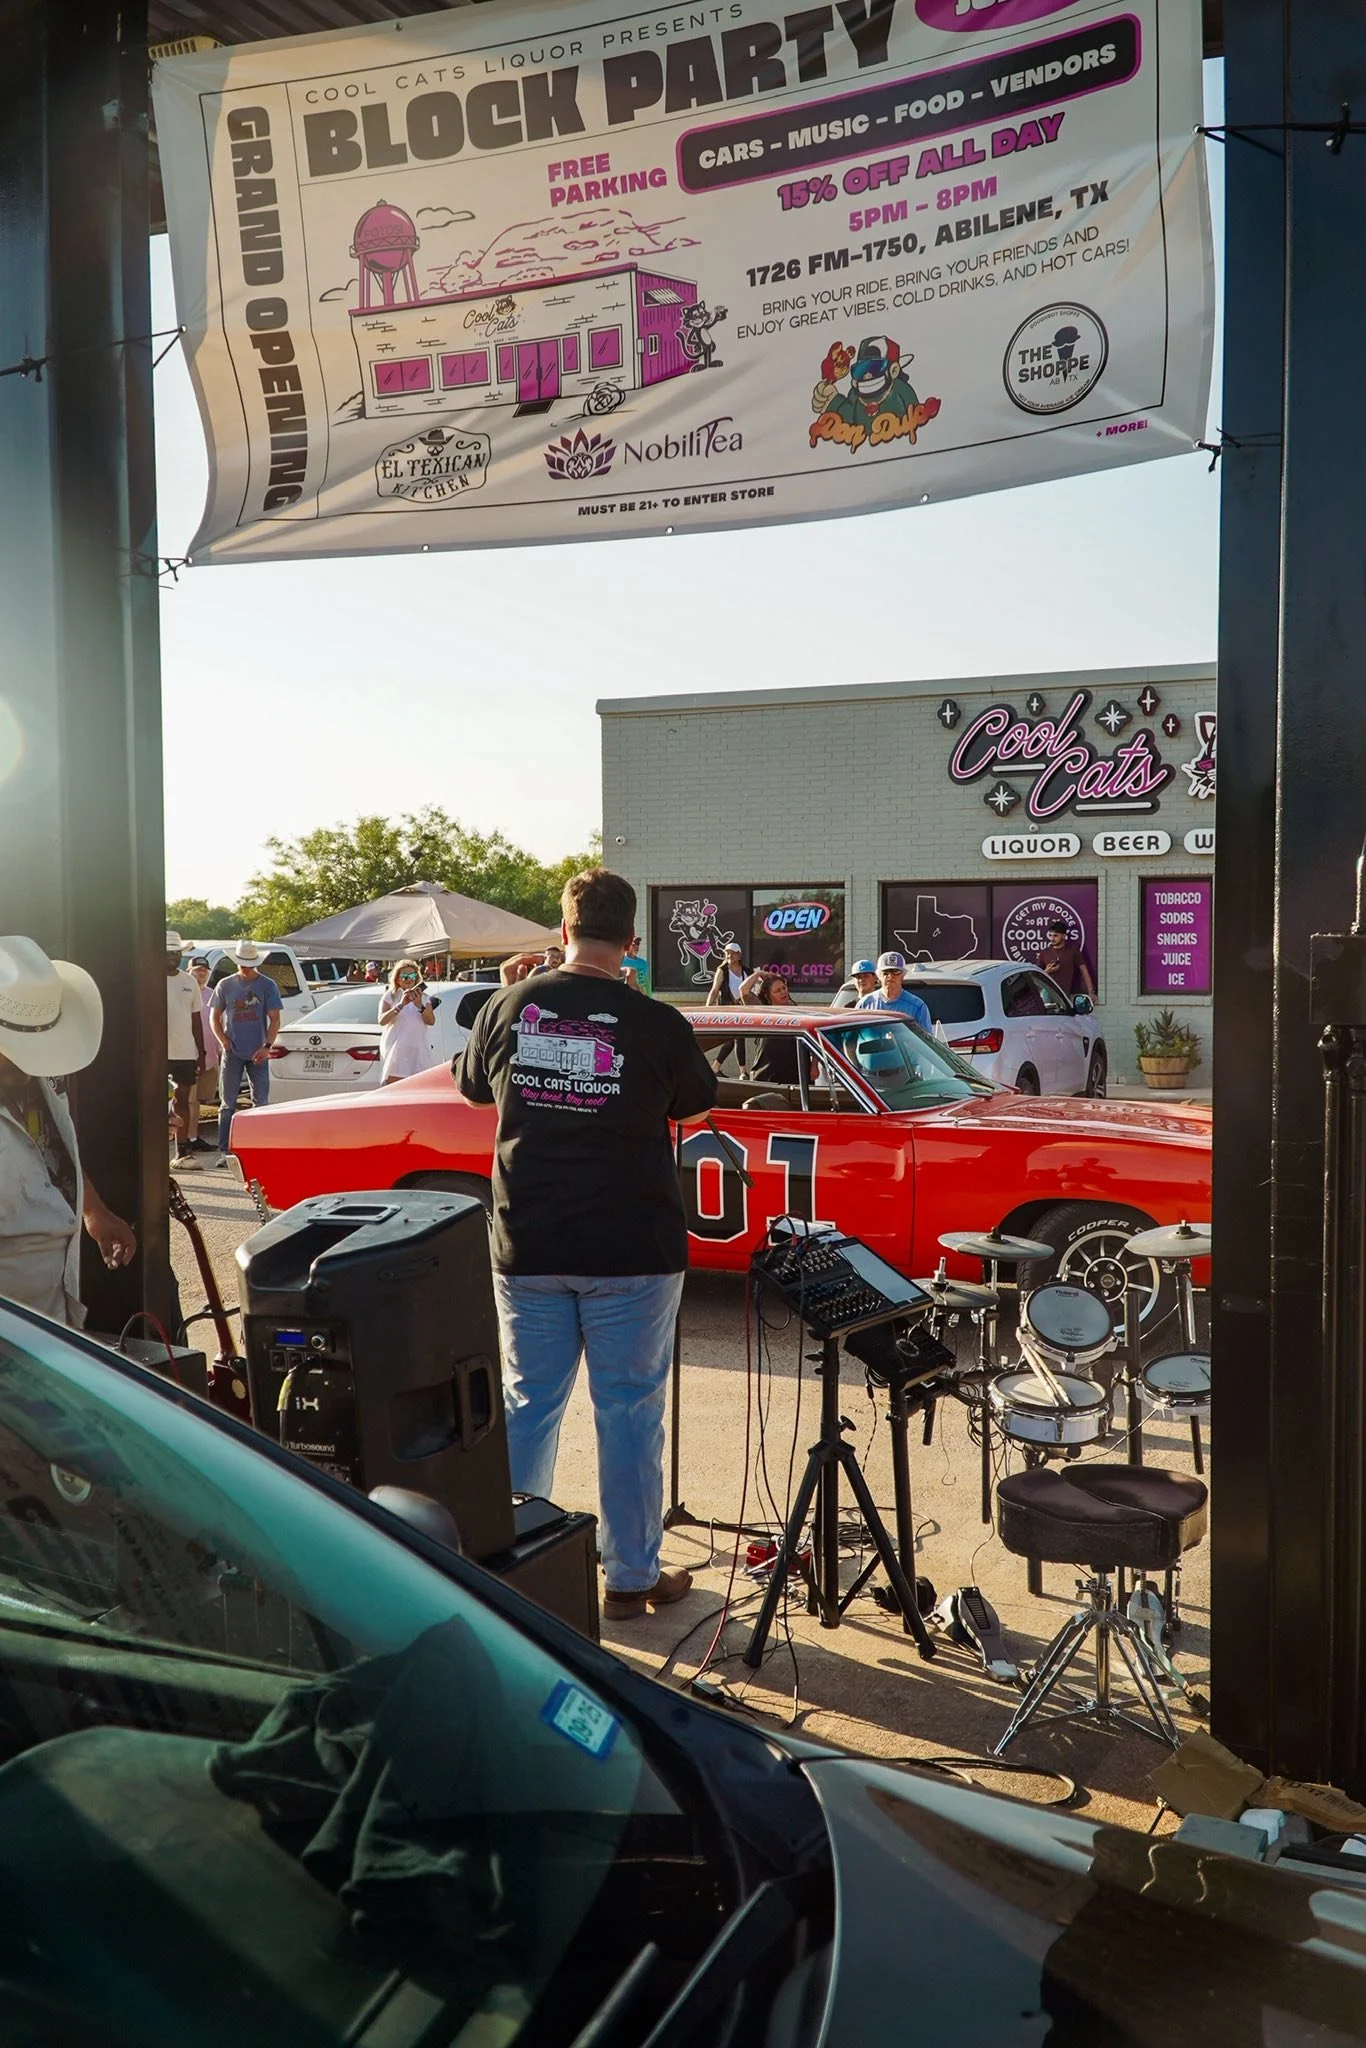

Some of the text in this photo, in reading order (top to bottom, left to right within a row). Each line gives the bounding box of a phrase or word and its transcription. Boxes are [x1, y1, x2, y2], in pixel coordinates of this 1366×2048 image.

[306, 3, 743, 103] COOL CATS LIQUOR PRESENTS
[303, 0, 896, 177] BLOCK PARTY
[699, 139, 764, 169] CARS
[788, 114, 869, 150] MUSIC
[895, 89, 964, 124] FOOD
[990, 43, 1116, 98] VENDORS
[548, 152, 611, 183] FREE
[777, 112, 1065, 211] 15% OFF ALL DAY
[550, 168, 667, 208] PARKING
[849, 200, 908, 232] 5PM
[936, 176, 997, 211] 8PM
[746, 180, 1109, 287] 1726 FM-1750, ABILENE, TX
[762, 296, 807, 316] BRING
[811, 286, 852, 306] YOUR
[895, 266, 941, 288] BRING
[946, 254, 988, 276] YOUR
[993, 237, 1058, 266] FRIENDS
[1063, 226, 1099, 247] AND
[737, 318, 785, 339] ENJOY
[789, 308, 838, 329] GREAT
[893, 288, 935, 308] COLD
[1003, 263, 1037, 283] AND
[1041, 251, 1076, 273] HOT
[1081, 238, 1129, 262] CARS!
[227, 106, 308, 511] GRAND OPENING
[463, 304, 495, 329] Cool
[485, 313, 518, 337] Cats
[1018, 344, 1053, 365] THE
[1018, 355, 1090, 383] SHOPPE
[1069, 374, 1078, 382] TX
[624, 416, 743, 464] NobiliTea
[1105, 419, 1148, 436] MORE!
[381, 453, 486, 479] EL TEXICAN
[391, 474, 470, 499] KITCHEN
[578, 486, 775, 516] MUST BE 21+ TO ENTER STORE
[951, 692, 1085, 780] Cool
[1029, 733, 1168, 818] Cats
[991, 835, 1160, 854] LIQUOR BEER
[1154, 891, 1201, 905] TOBACCO
[767, 908, 823, 931] OPEN
[1015, 906, 1030, 921] GET
[1031, 902, 1046, 912] MY
[1048, 903, 1076, 927] BOOZE
[1036, 917, 1049, 926] AT
[1159, 912, 1194, 925] SODAS
[1007, 930, 1043, 940] COOL
[1157, 932, 1198, 946] SNACKS
[801, 963, 833, 976] CATS
[1161, 952, 1192, 966] JUICE
[1168, 973, 1185, 986] ICE
[760, 1016, 801, 1027] LEE
[511, 1073, 621, 1095] COOL CATS LIQUOR
[675, 1130, 836, 1247] 01
[1068, 1219, 1130, 1241] COOPER
[289, 1441, 335, 1453] Turbosound
